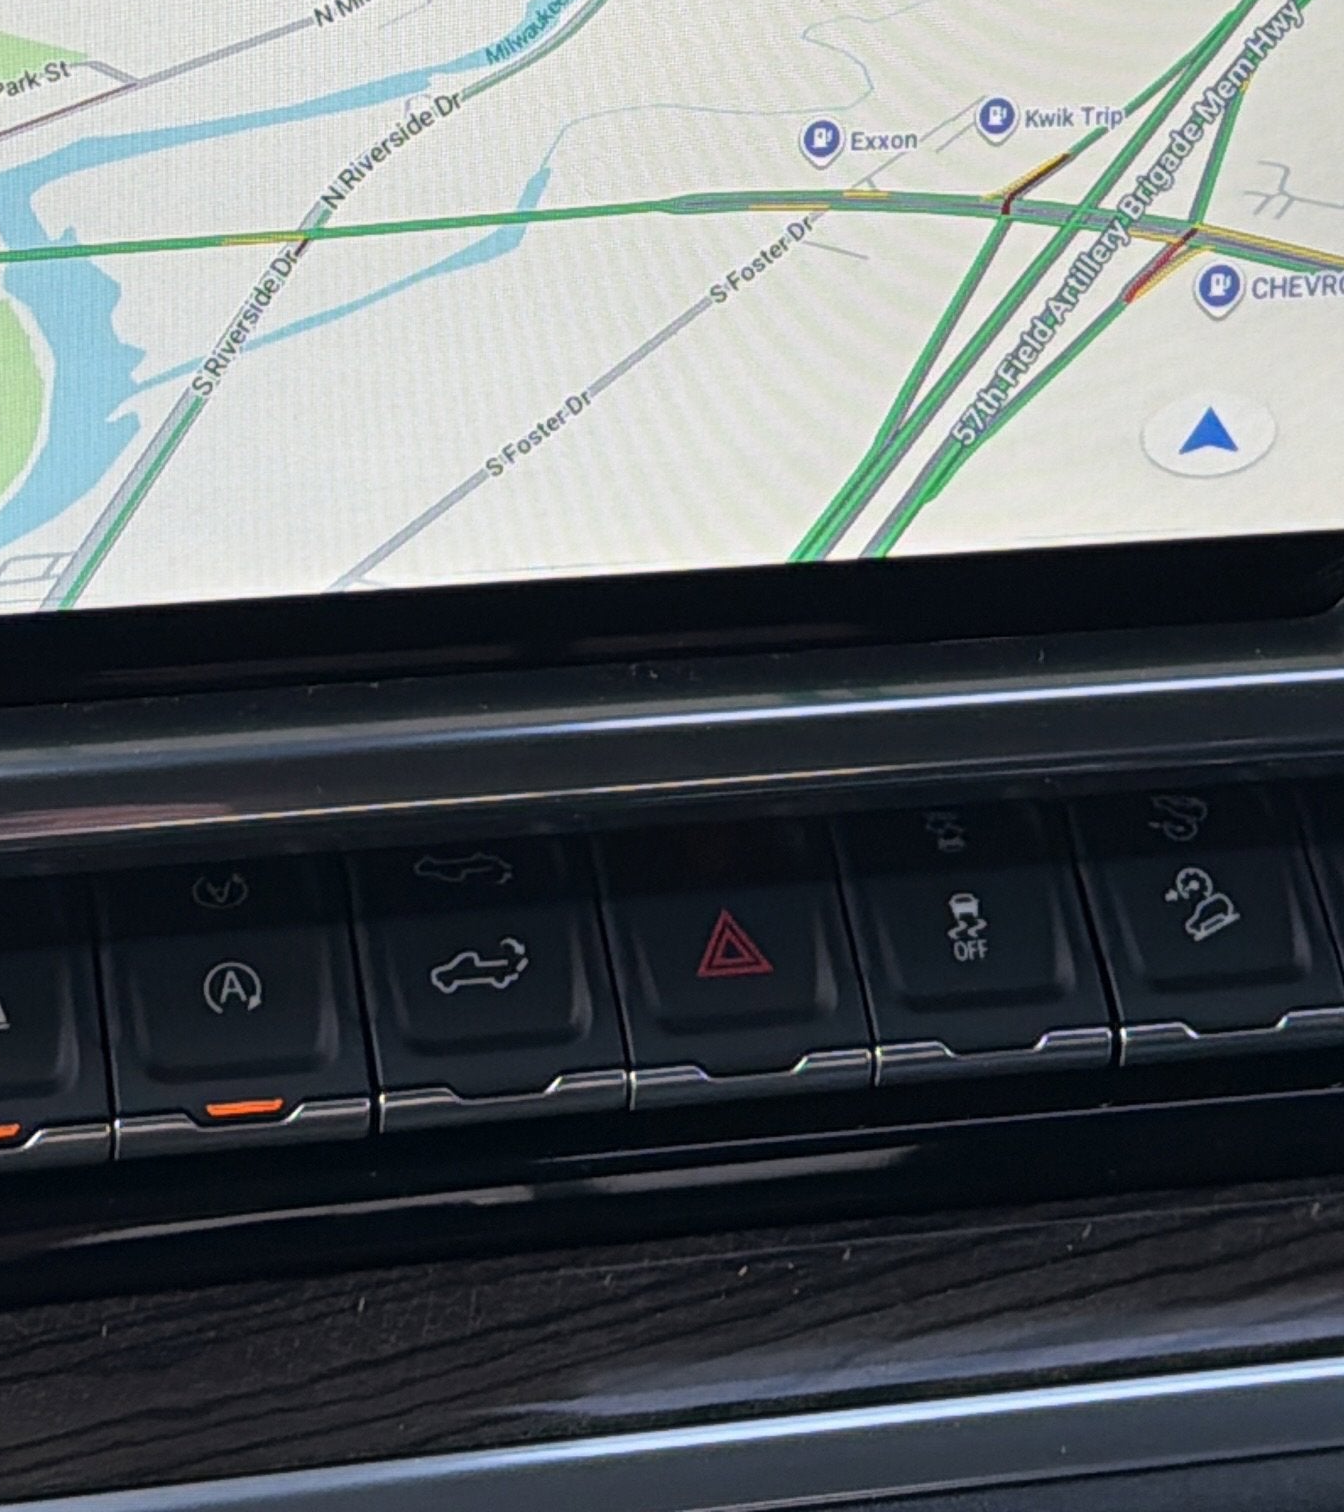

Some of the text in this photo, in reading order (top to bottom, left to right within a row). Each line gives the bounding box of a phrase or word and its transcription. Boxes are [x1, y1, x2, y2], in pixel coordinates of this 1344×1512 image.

[313, 5, 334, 28] N
[41, 60, 71, 84] St
[850, 130, 919, 152] Exxon
[1024, 104, 1124, 133] Kwik Trip
[321, 89, 464, 211] N Riverside Dr
[951, 0, 1303, 446] 57th Field Artillery Brigade Mem Hwy
[709, 216, 813, 305] S Foster Dr
[191, 248, 300, 397] S Riverside Dr
[484, 389, 594, 478] S Foster Dr
[953, 939, 988, 962] OFF
